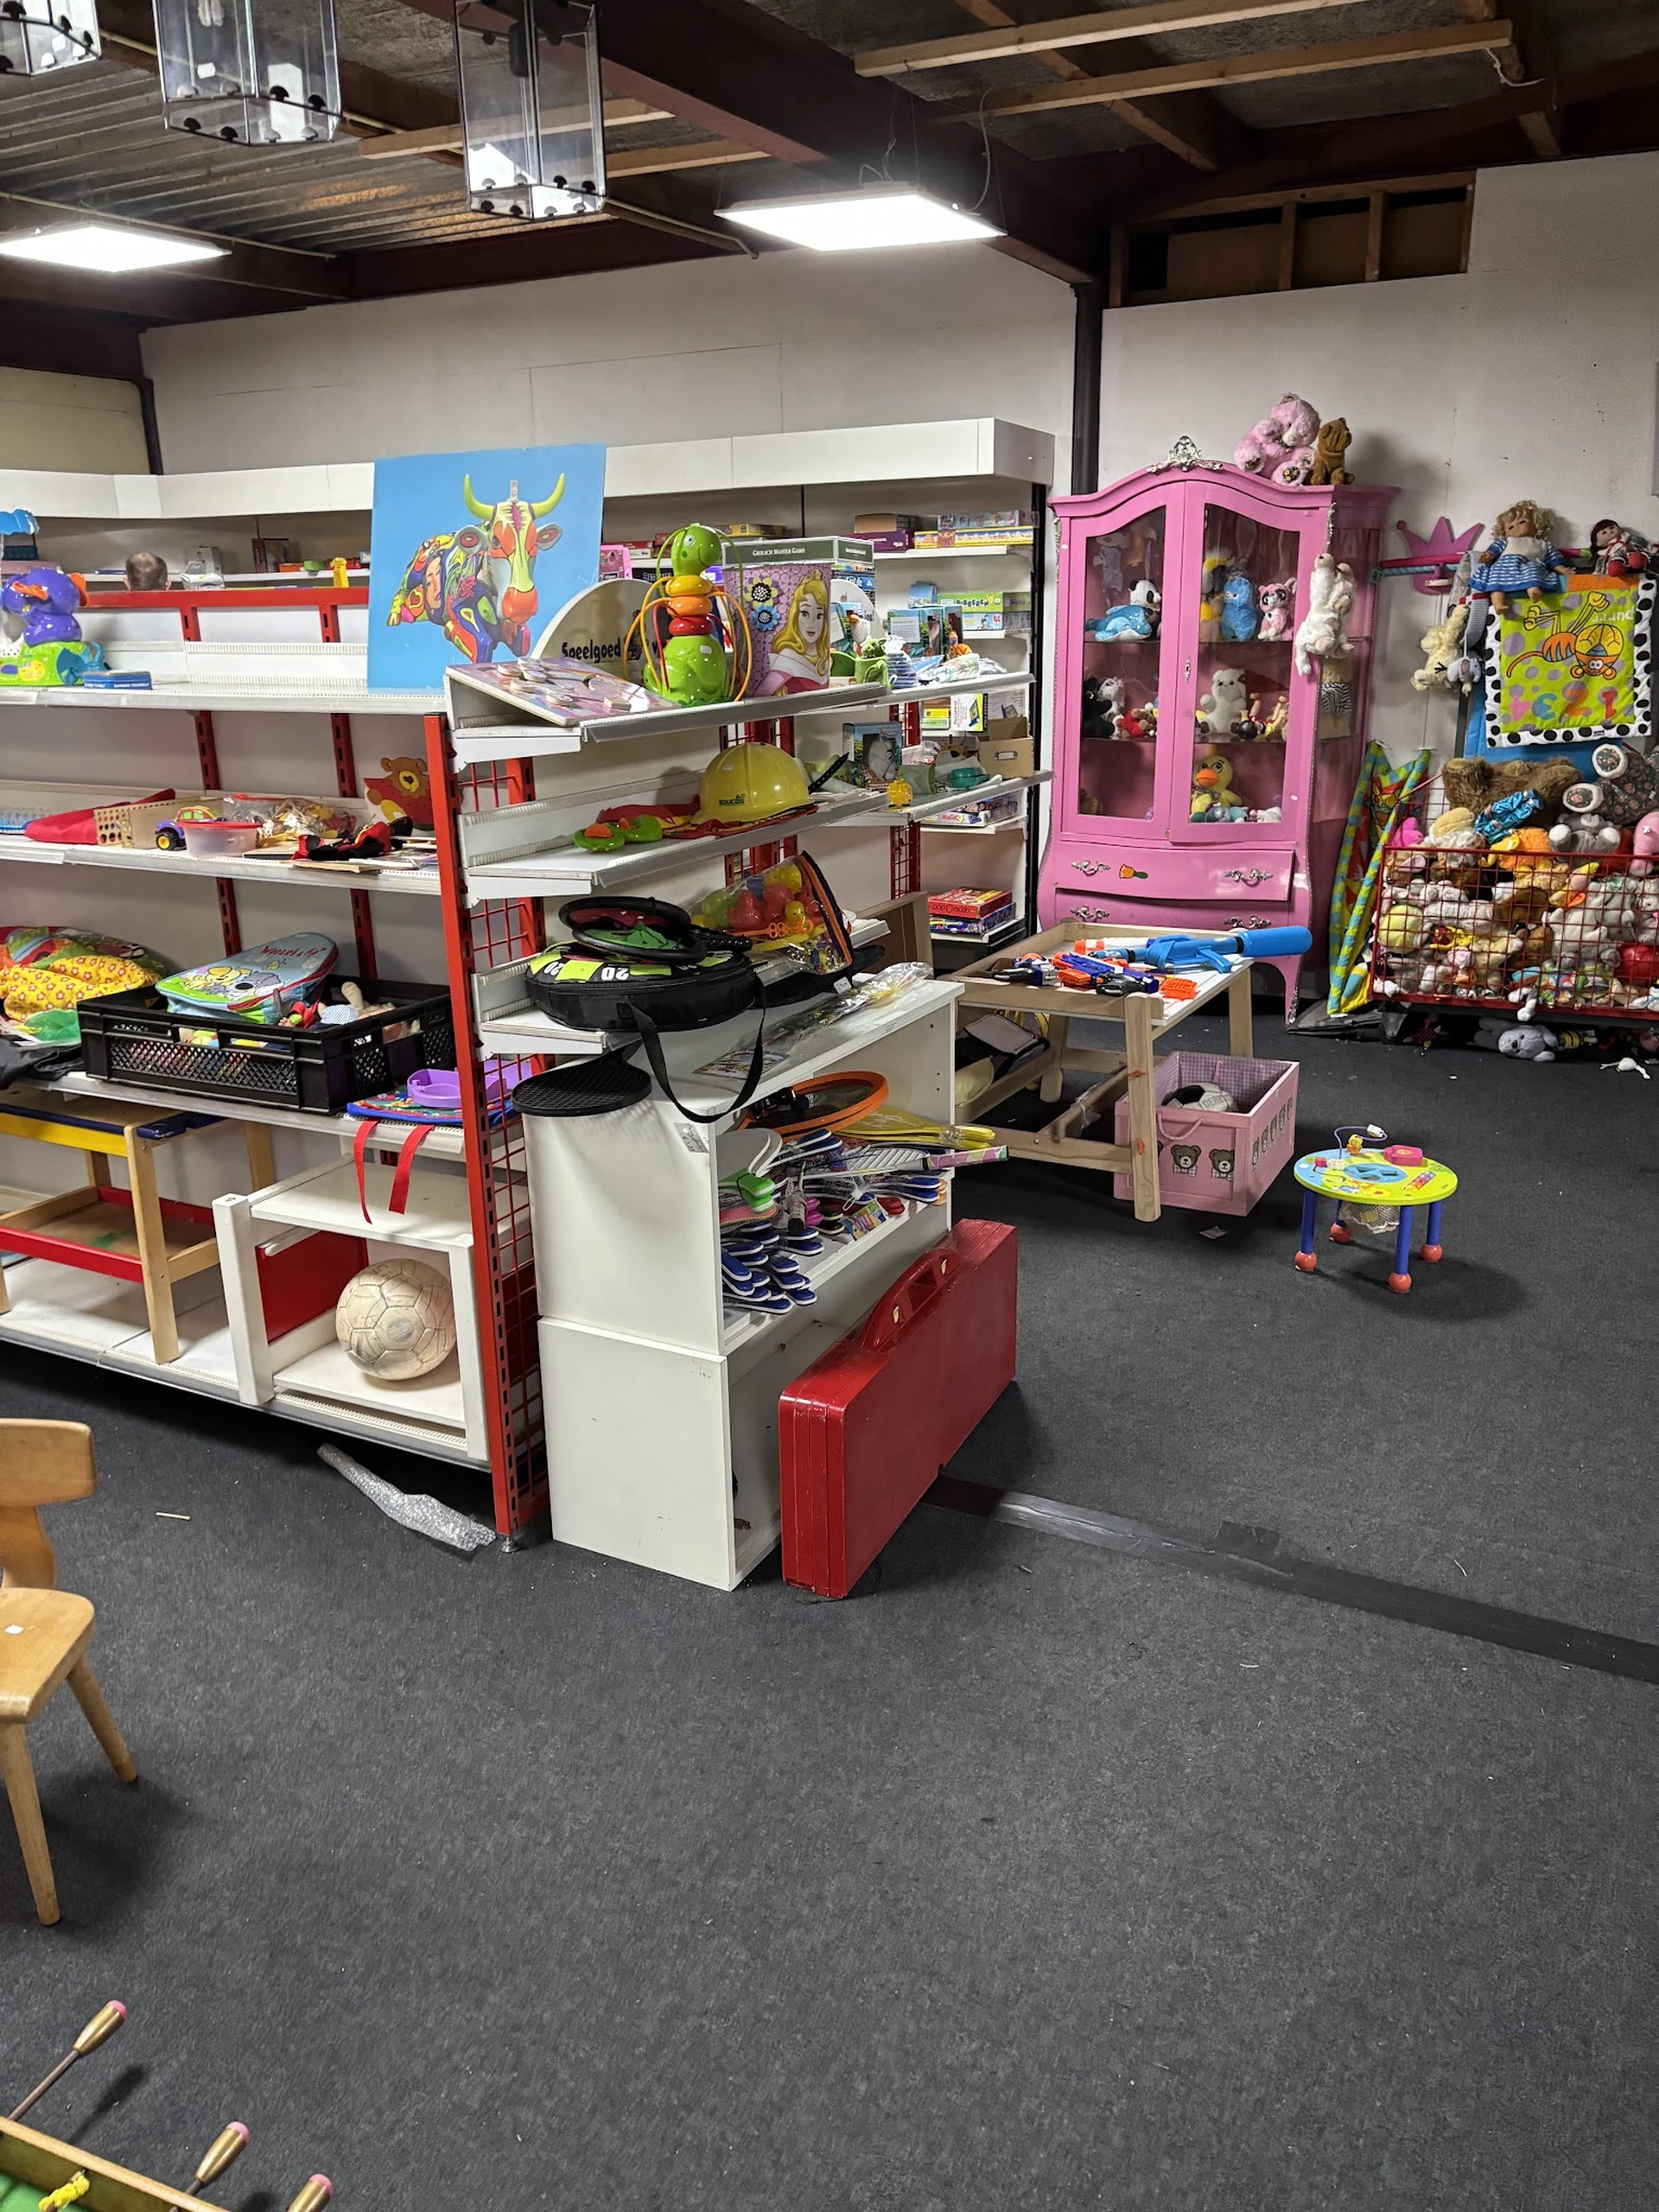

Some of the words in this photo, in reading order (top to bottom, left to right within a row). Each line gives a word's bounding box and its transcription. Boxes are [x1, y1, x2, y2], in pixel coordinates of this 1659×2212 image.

[562, 638, 621, 664] Speelgoed
[1510, 694, 1532, 721] 4
[1538, 693, 1557, 720] 3
[1565, 689, 1589, 716] 2
[1601, 690, 1618, 719] 1
[601, 967, 630, 981] 20
